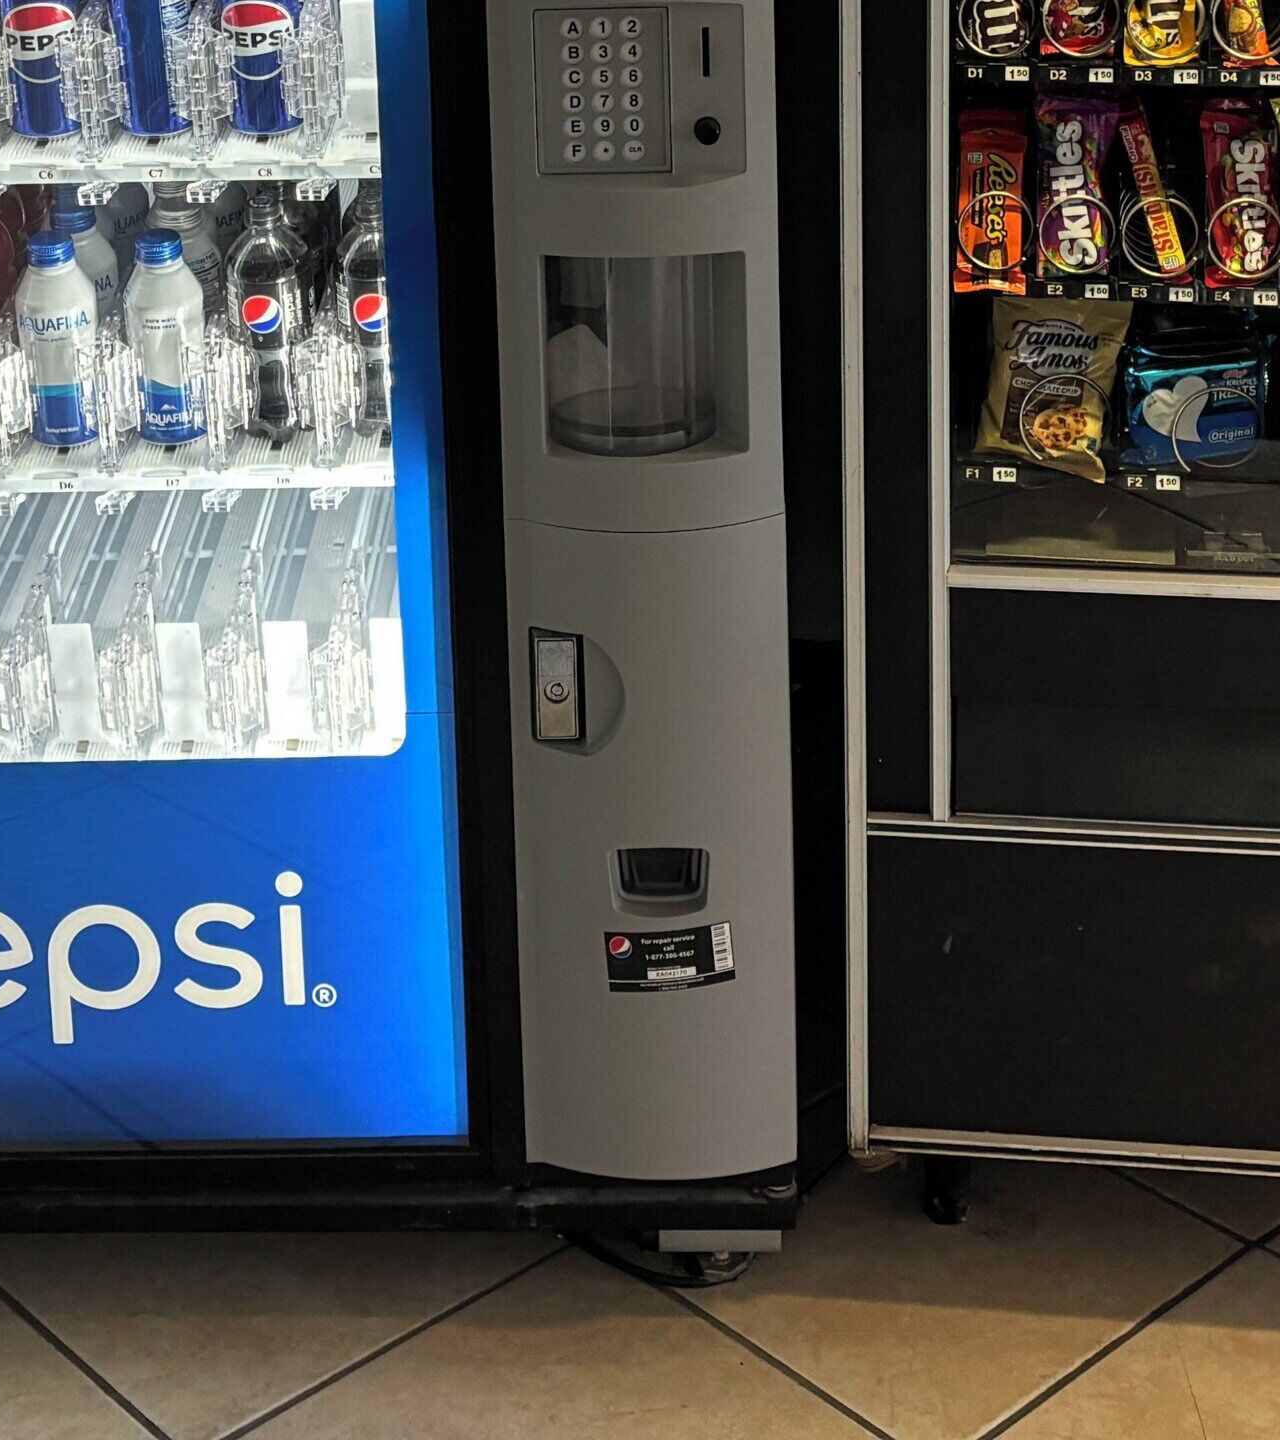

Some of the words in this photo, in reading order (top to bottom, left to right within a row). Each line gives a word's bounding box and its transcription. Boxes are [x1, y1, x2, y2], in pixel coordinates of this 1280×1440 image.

[567, 22, 579, 34] A
[598, 21, 605, 34] 1
[627, 21, 637, 33] 2
[568, 47, 579, 59] B
[599, 46, 608, 58] 3
[628, 45, 638, 58] 4
[569, 71, 580, 84] C
[599, 70, 609, 83] 5
[629, 70, 638, 82] 6
[968, 68, 982, 78] D1
[570, 96, 581, 109] D
[599, 95, 609, 108] 7
[629, 94, 639, 107] 8
[571, 120, 581, 133] E
[600, 120, 610, 132] 9
[630, 120, 639, 132] 0
[572, 145, 582, 157] F
[1055, 120, 1099, 266] Skittles
[1047, 285, 1064, 295] E2
[1006, 320, 1099, 349] Famous
[1010, 350, 1087, 370] Amos
[1209, 427, 1255, 443] Original
[966, 468, 980, 478] F1
[1127, 477, 1143, 486] F2
[653, 937, 672, 945] repair
[673, 934, 695, 943] service
